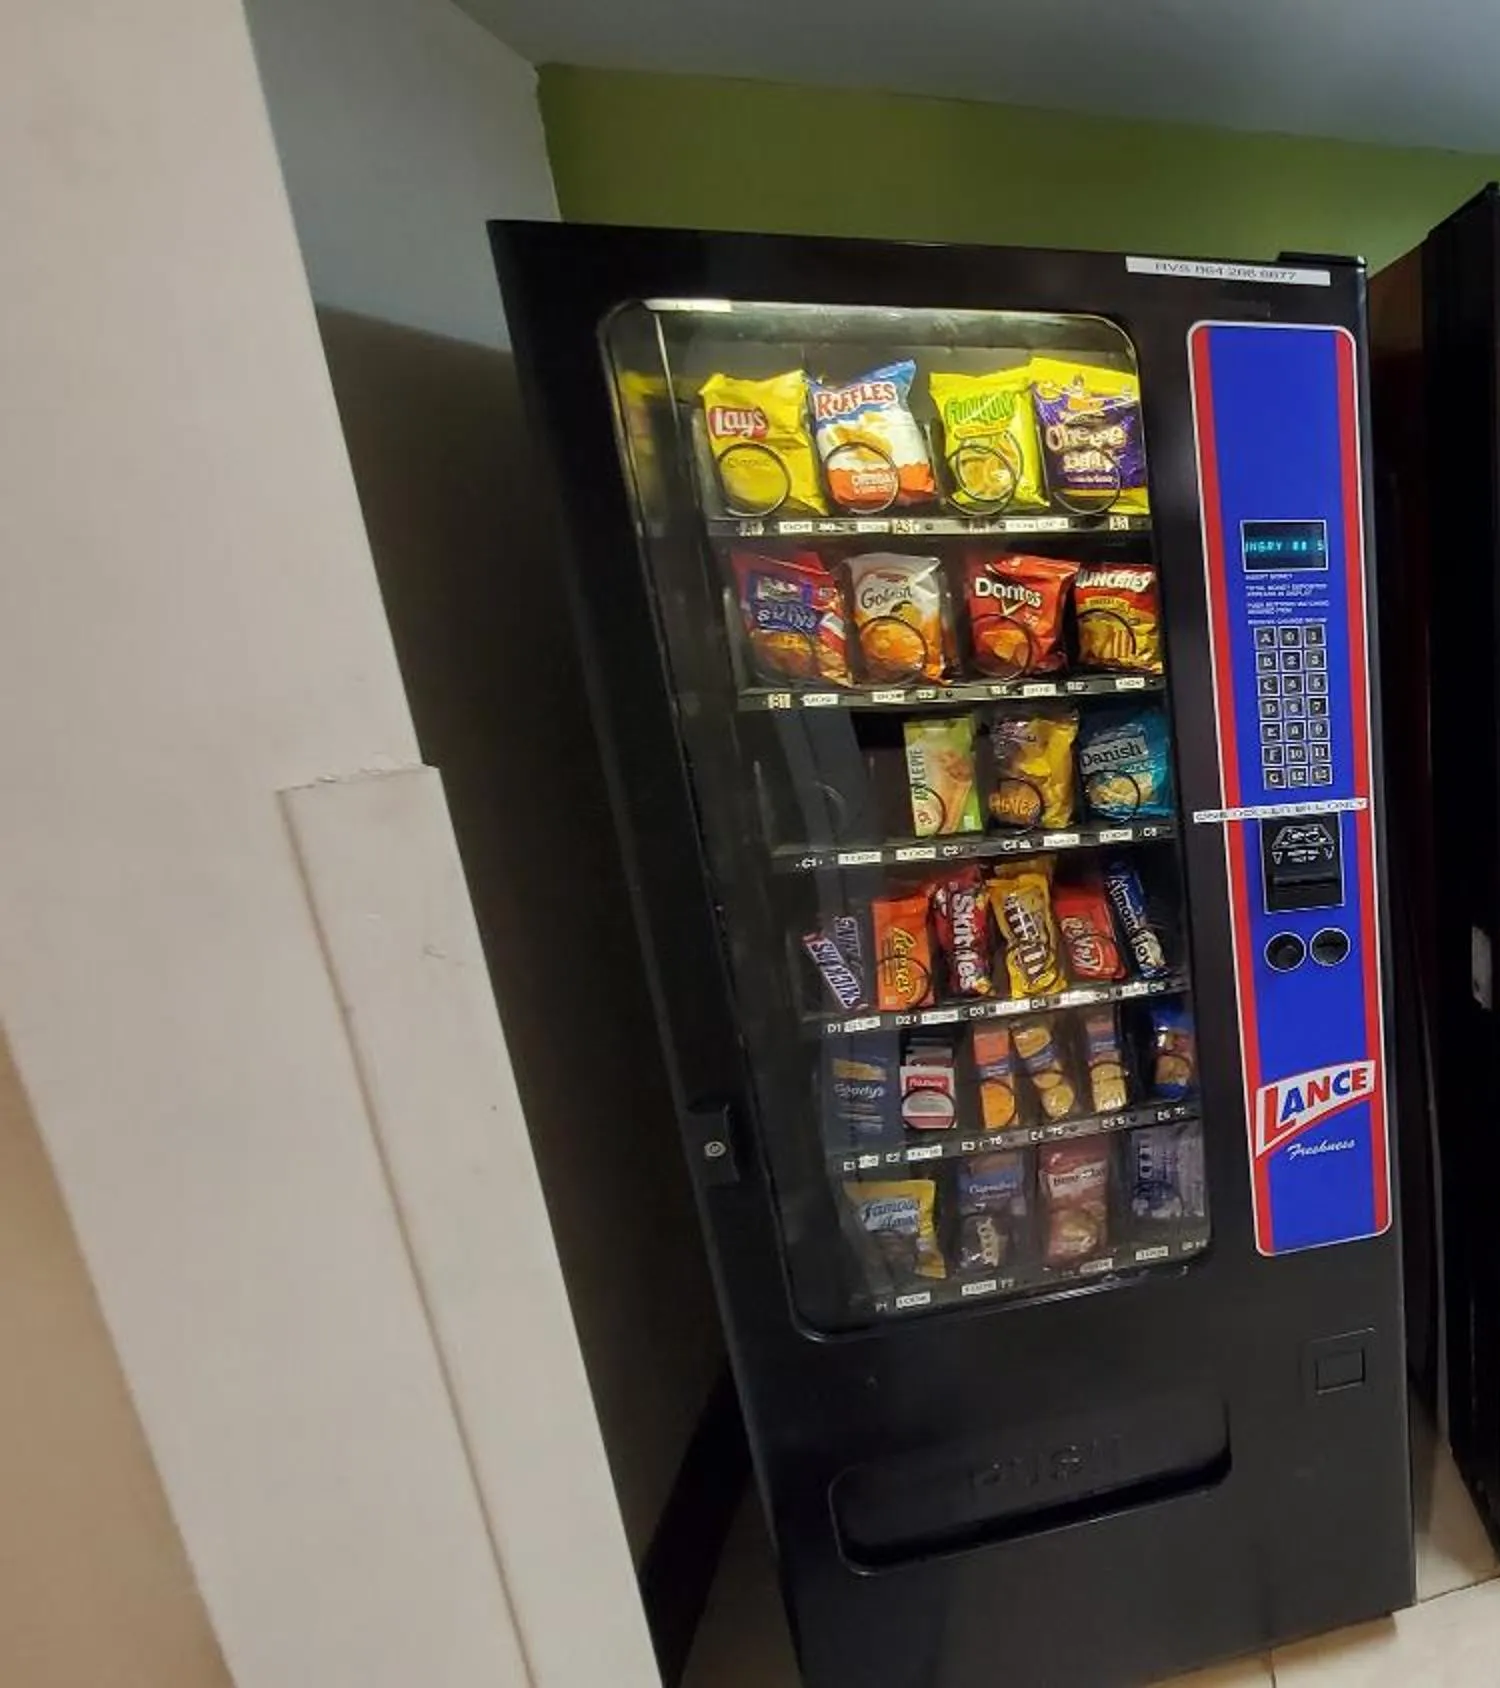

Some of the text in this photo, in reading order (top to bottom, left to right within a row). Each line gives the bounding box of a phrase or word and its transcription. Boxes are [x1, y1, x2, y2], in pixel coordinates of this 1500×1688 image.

[1081, 741, 1144, 768] Danish
[1263, 1067, 1368, 1147] LANCE
[1287, 1138, 1356, 1160] Freshness
